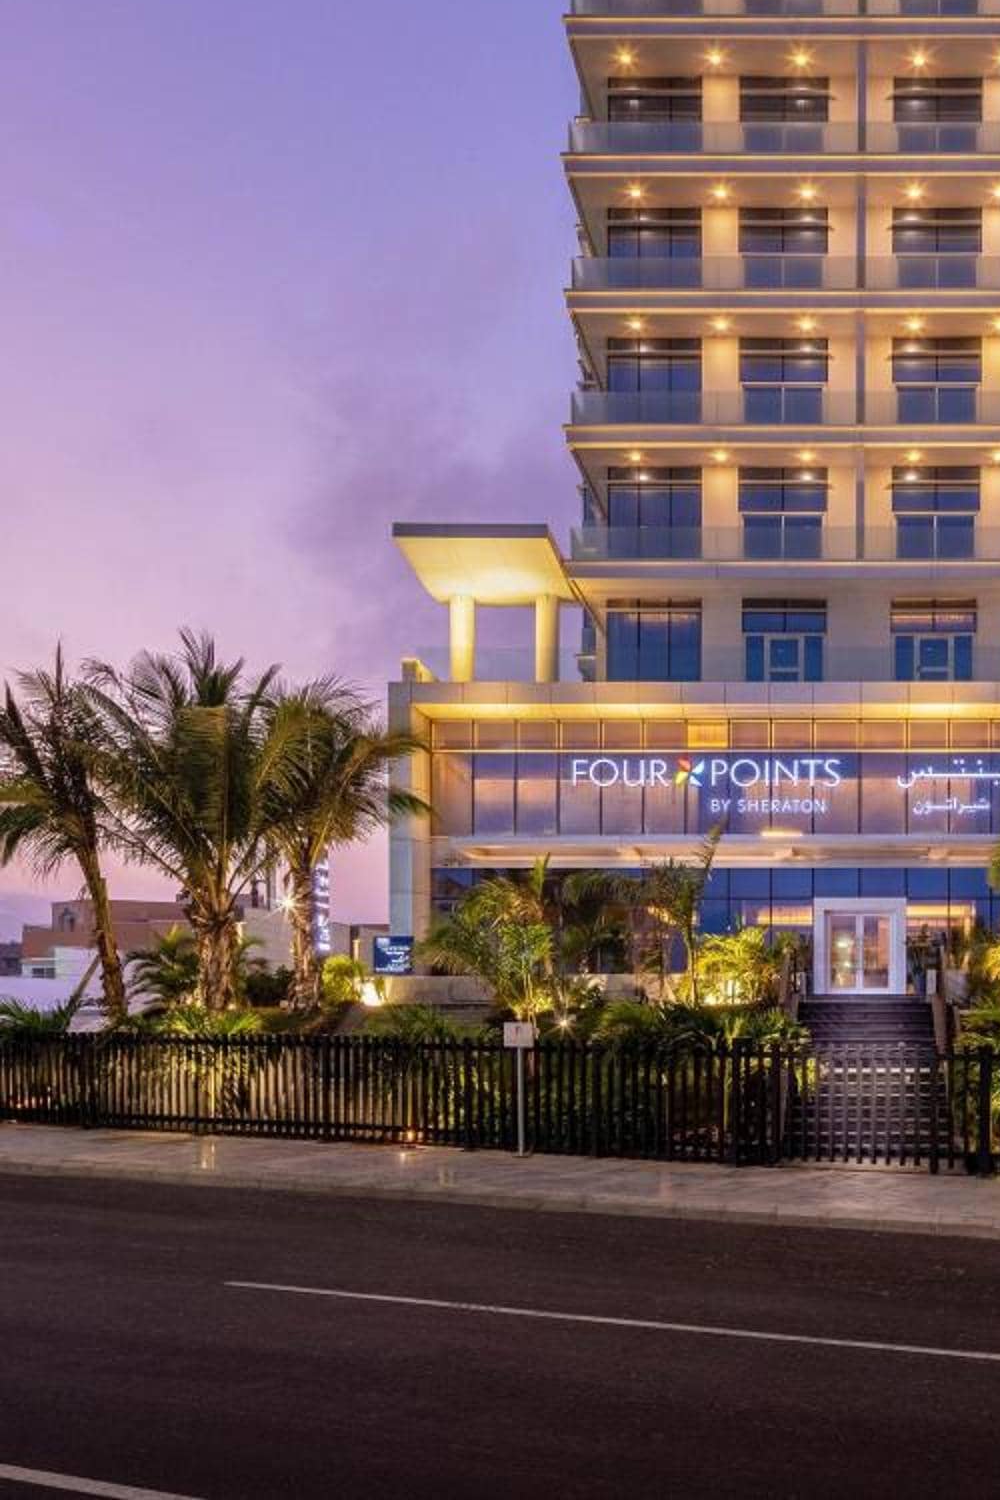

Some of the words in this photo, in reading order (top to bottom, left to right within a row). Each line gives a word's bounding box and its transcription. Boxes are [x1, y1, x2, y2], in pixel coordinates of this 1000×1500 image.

[571, 758, 669, 787] FOUR
[710, 758, 842, 787] POINTS
[710, 799, 730, 813] BY
[739, 799, 828, 813] SHERATON
[912, 797, 991, 815] شيراتون
